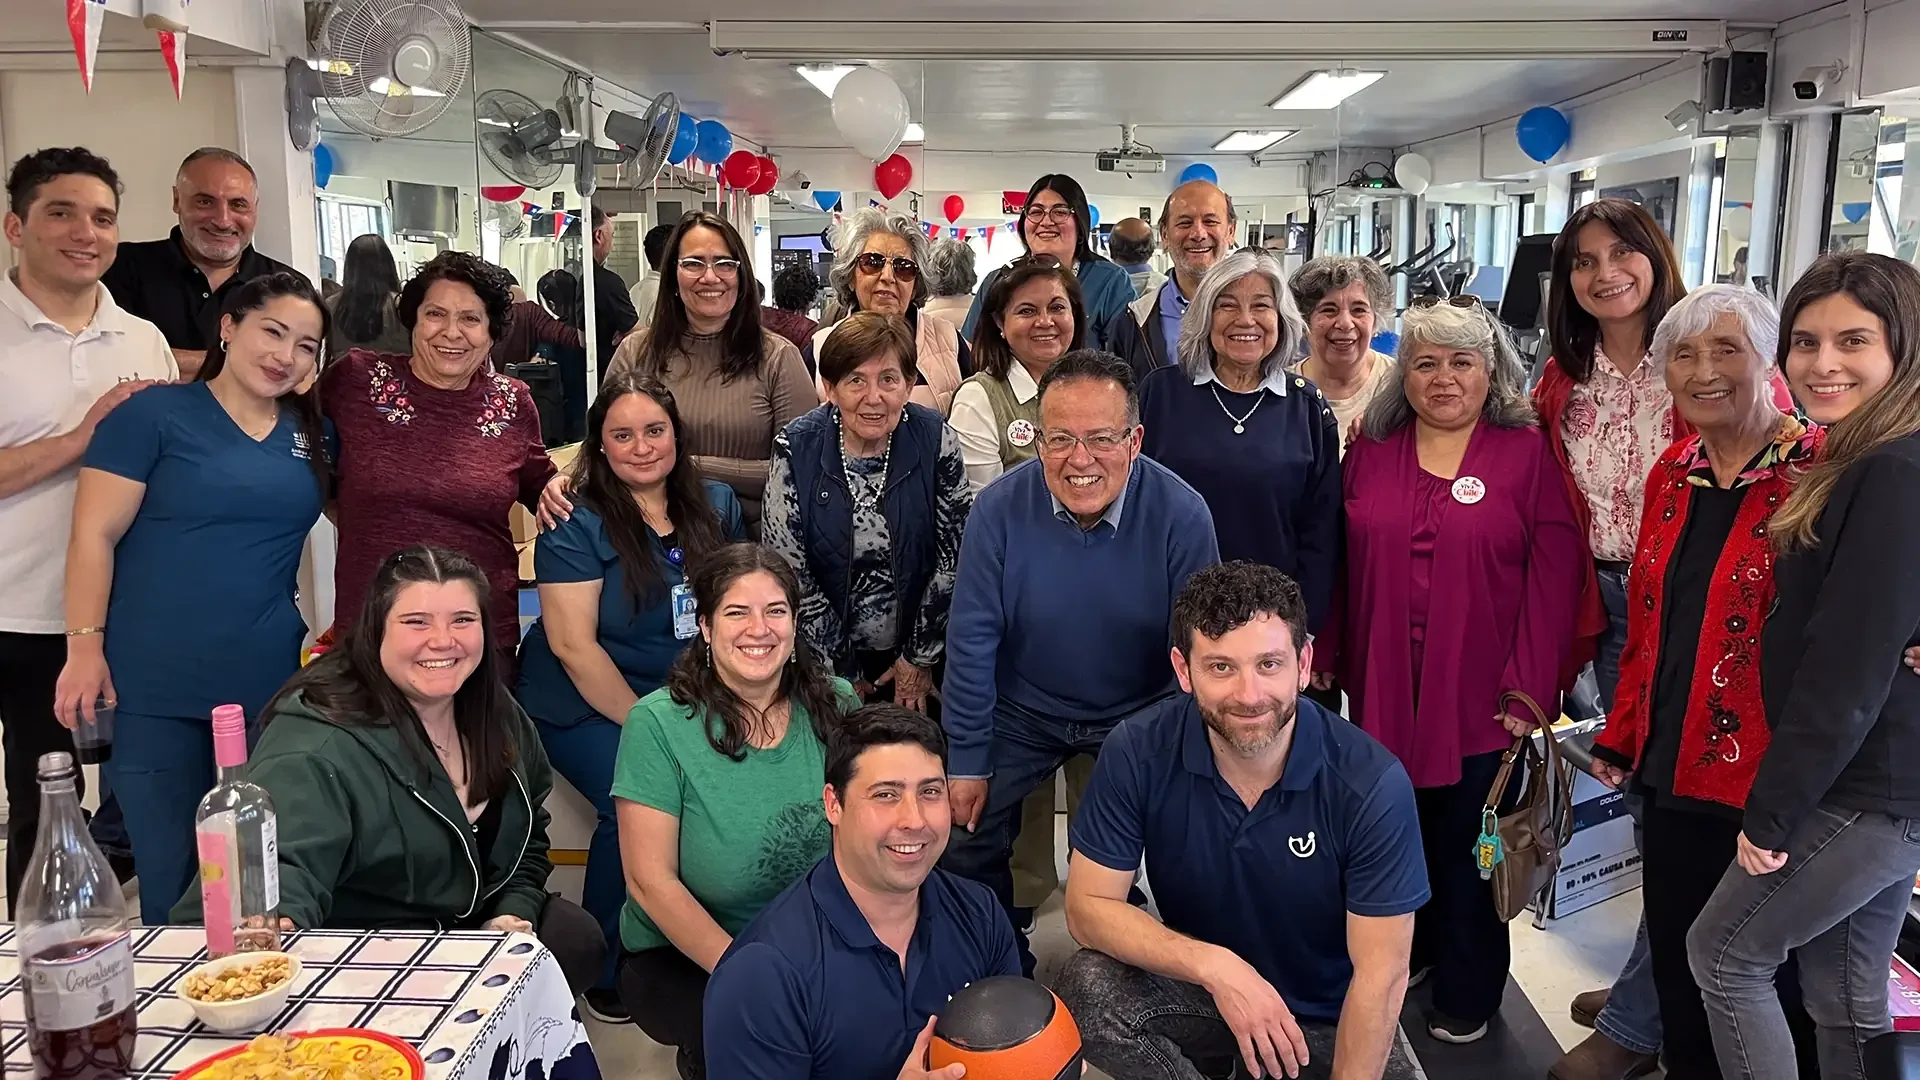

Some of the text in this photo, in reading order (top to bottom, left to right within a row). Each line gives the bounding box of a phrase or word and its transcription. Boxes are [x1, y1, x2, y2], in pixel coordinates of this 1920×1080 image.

[1599, 793, 1624, 806] DOLOR
[1607, 808, 1613, 816] 1
[1598, 861, 1624, 877] CAUSA
